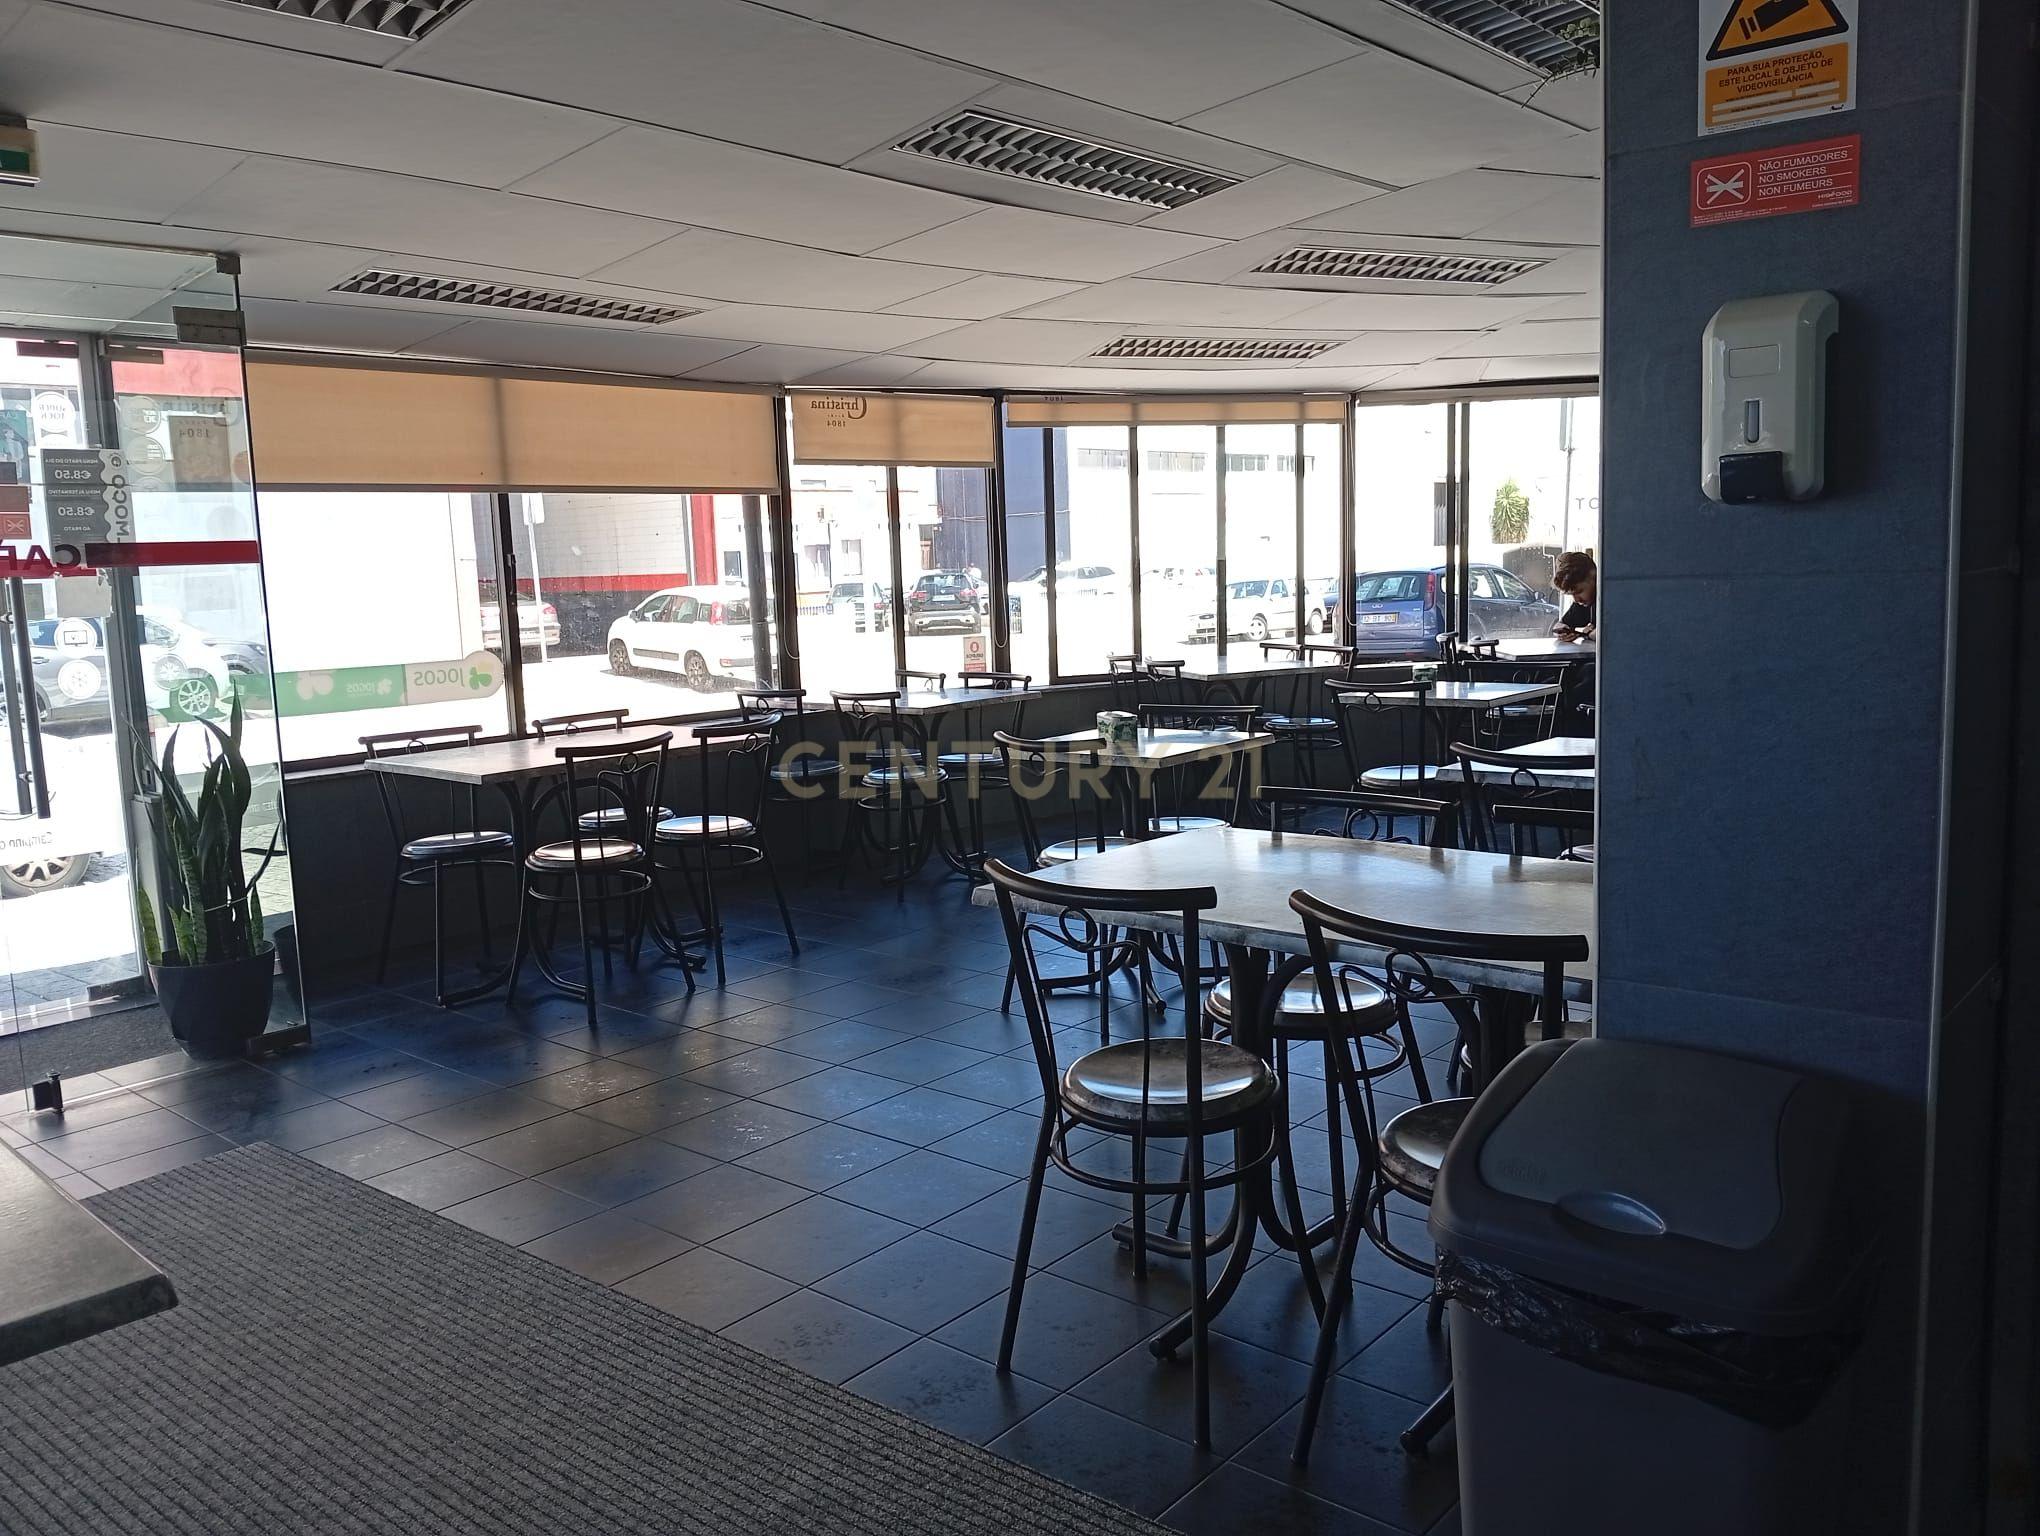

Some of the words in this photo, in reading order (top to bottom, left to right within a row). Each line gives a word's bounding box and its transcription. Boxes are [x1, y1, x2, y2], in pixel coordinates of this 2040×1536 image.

[1719, 76, 1741, 88] ESTE
[1742, 70, 1767, 85] LOCAL
[1769, 67, 1775, 80] É
[1782, 60, 1819, 75] OBJETO
[1821, 58, 1834, 69] DE
[1727, 66, 1750, 77] PARA
[1752, 61, 1771, 73] SUA
[1737, 71, 1814, 93] VIDEOVIGILÂNCIA
[1759, 160, 1781, 172] NÃO
[1783, 150, 1848, 168] FUMADORES
[1759, 173, 1775, 185] NO
[1776, 166, 1827, 182] SMOKERS
[1759, 186, 1781, 198] NON
[1783, 178, 1833, 193] FUMEURS
